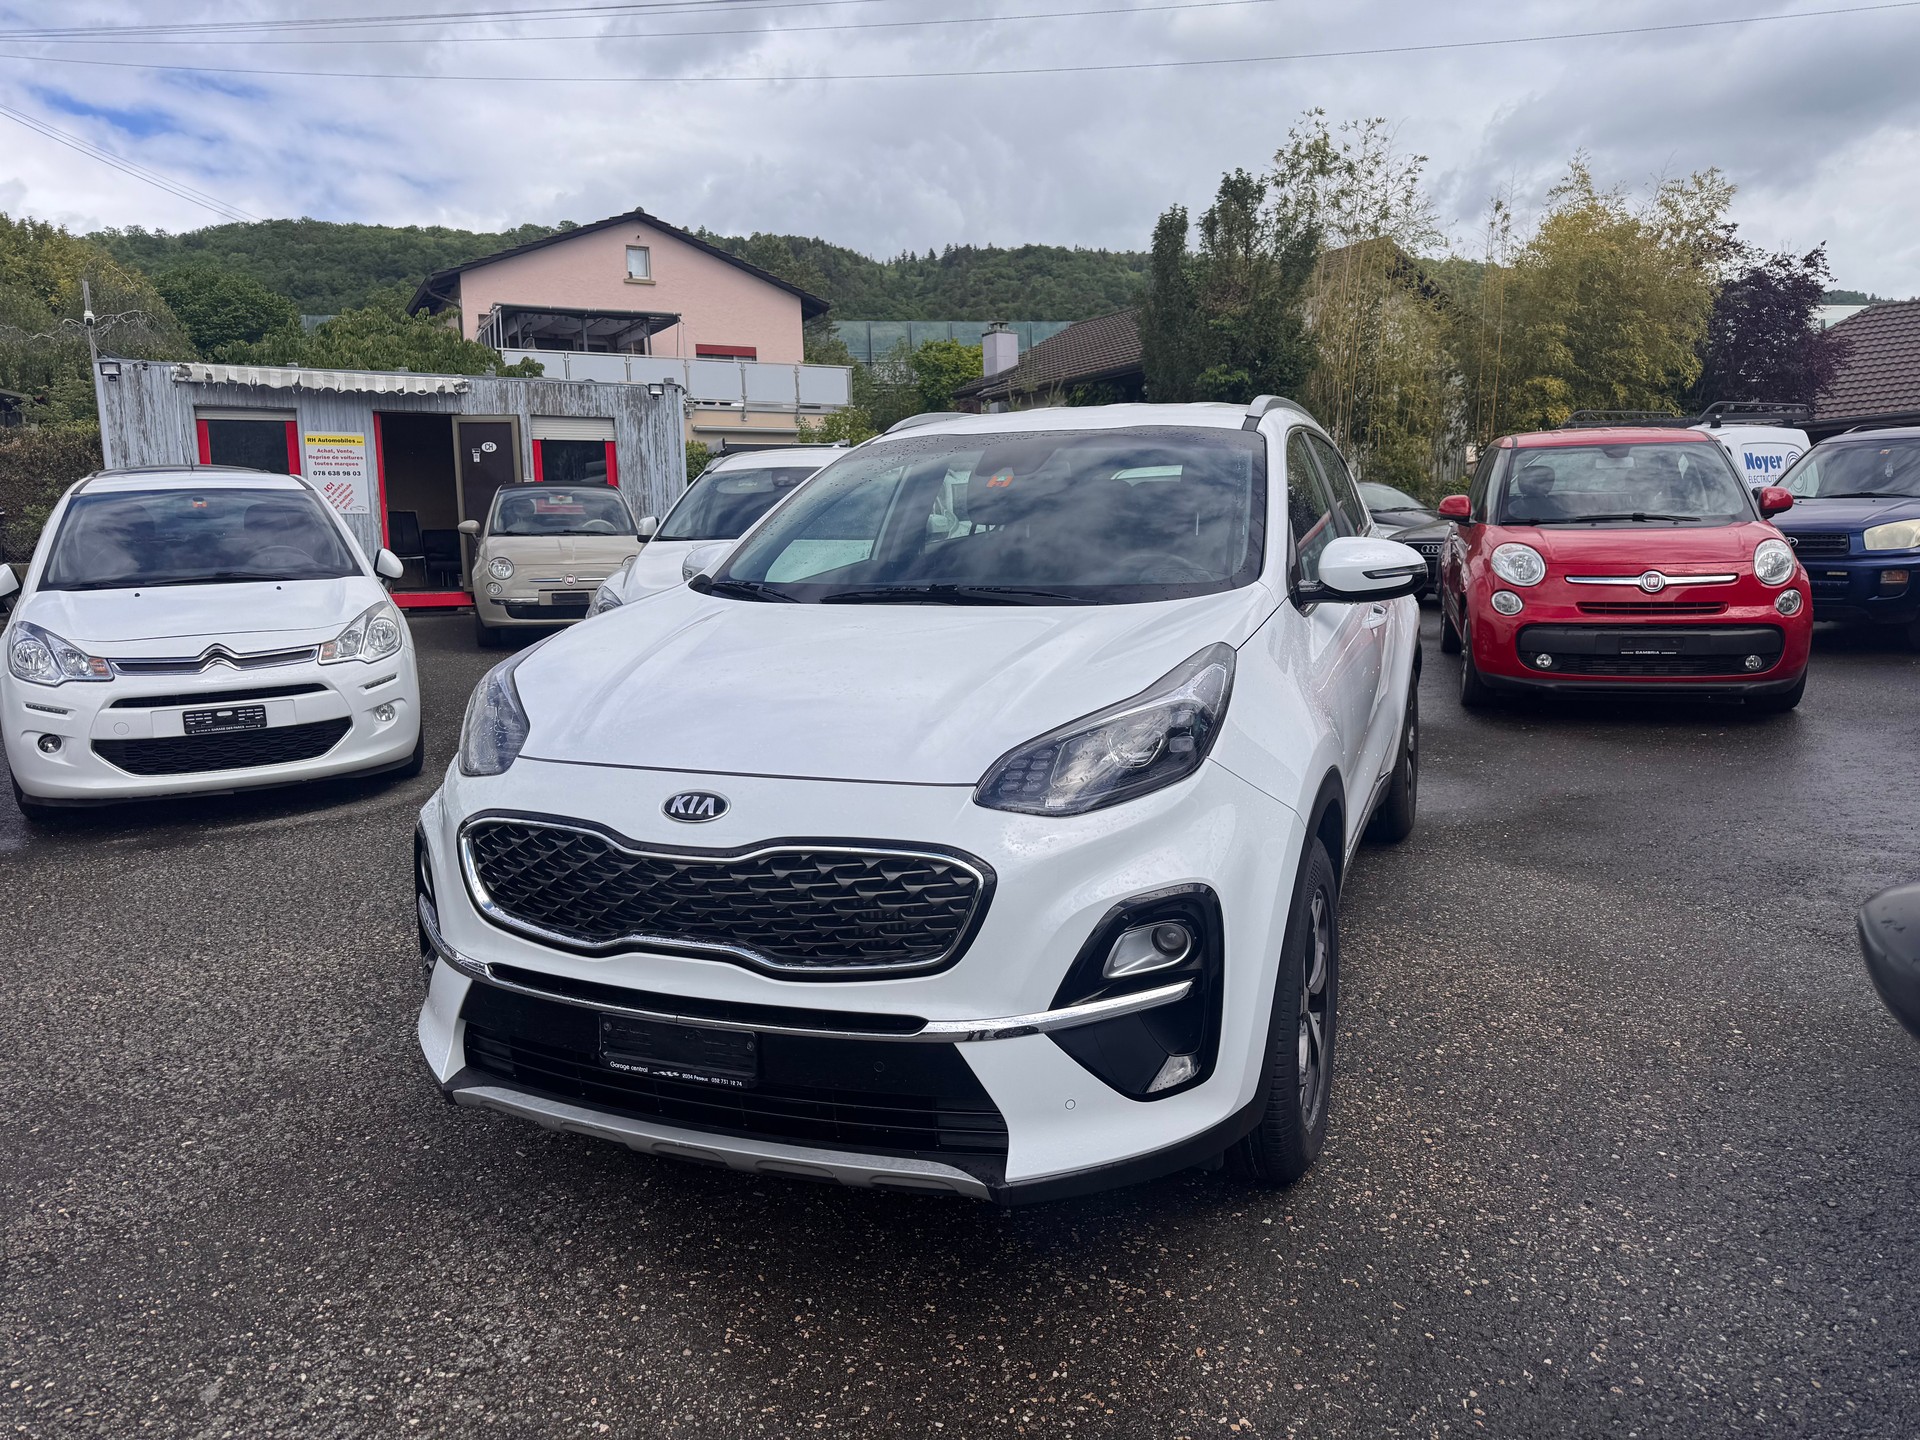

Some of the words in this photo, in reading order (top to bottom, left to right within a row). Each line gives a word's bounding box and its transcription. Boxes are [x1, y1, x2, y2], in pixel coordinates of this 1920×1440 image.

[1744, 452, 1782, 473] Noyer
[324, 482, 335, 492] ICI
[670, 795, 715, 816] KIA
[610, 1061, 630, 1071] Garage
